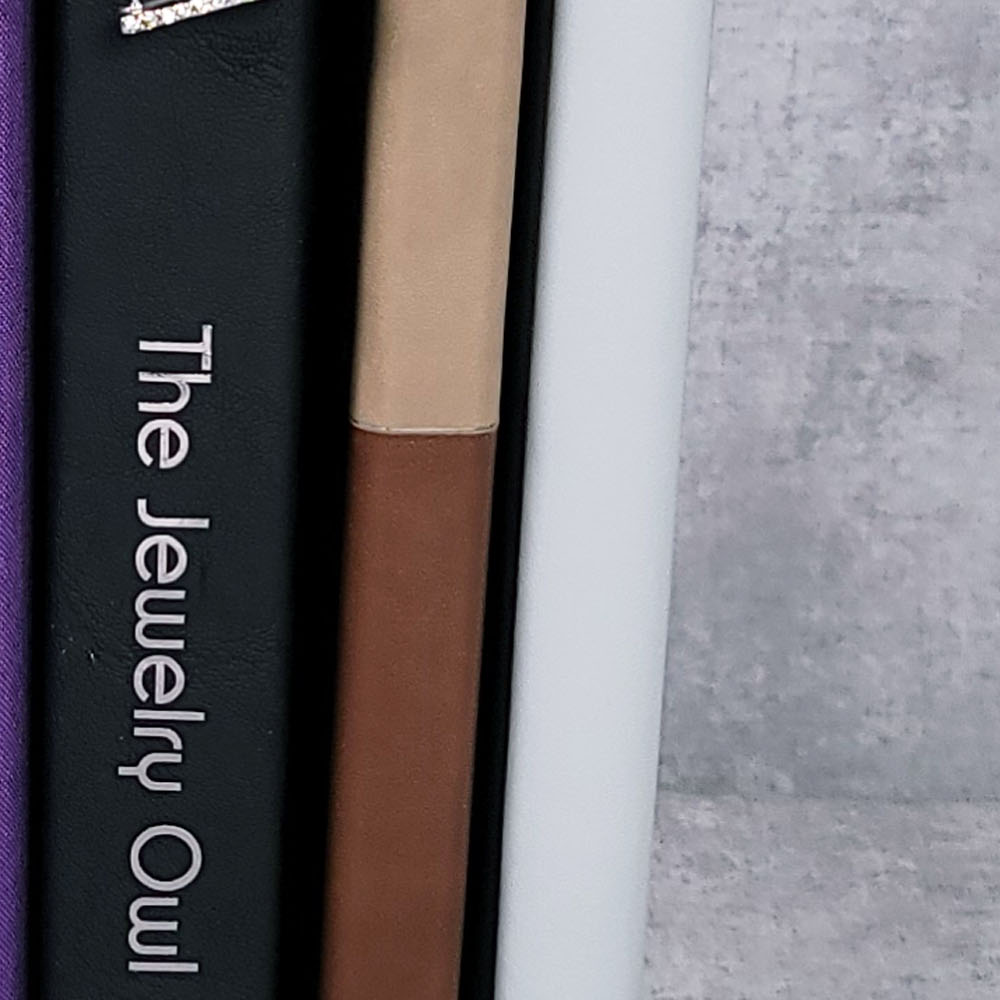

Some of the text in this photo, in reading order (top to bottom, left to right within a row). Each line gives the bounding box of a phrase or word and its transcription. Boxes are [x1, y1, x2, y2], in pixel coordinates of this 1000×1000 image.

[117, 324, 213, 973] The Jewelry Owl
